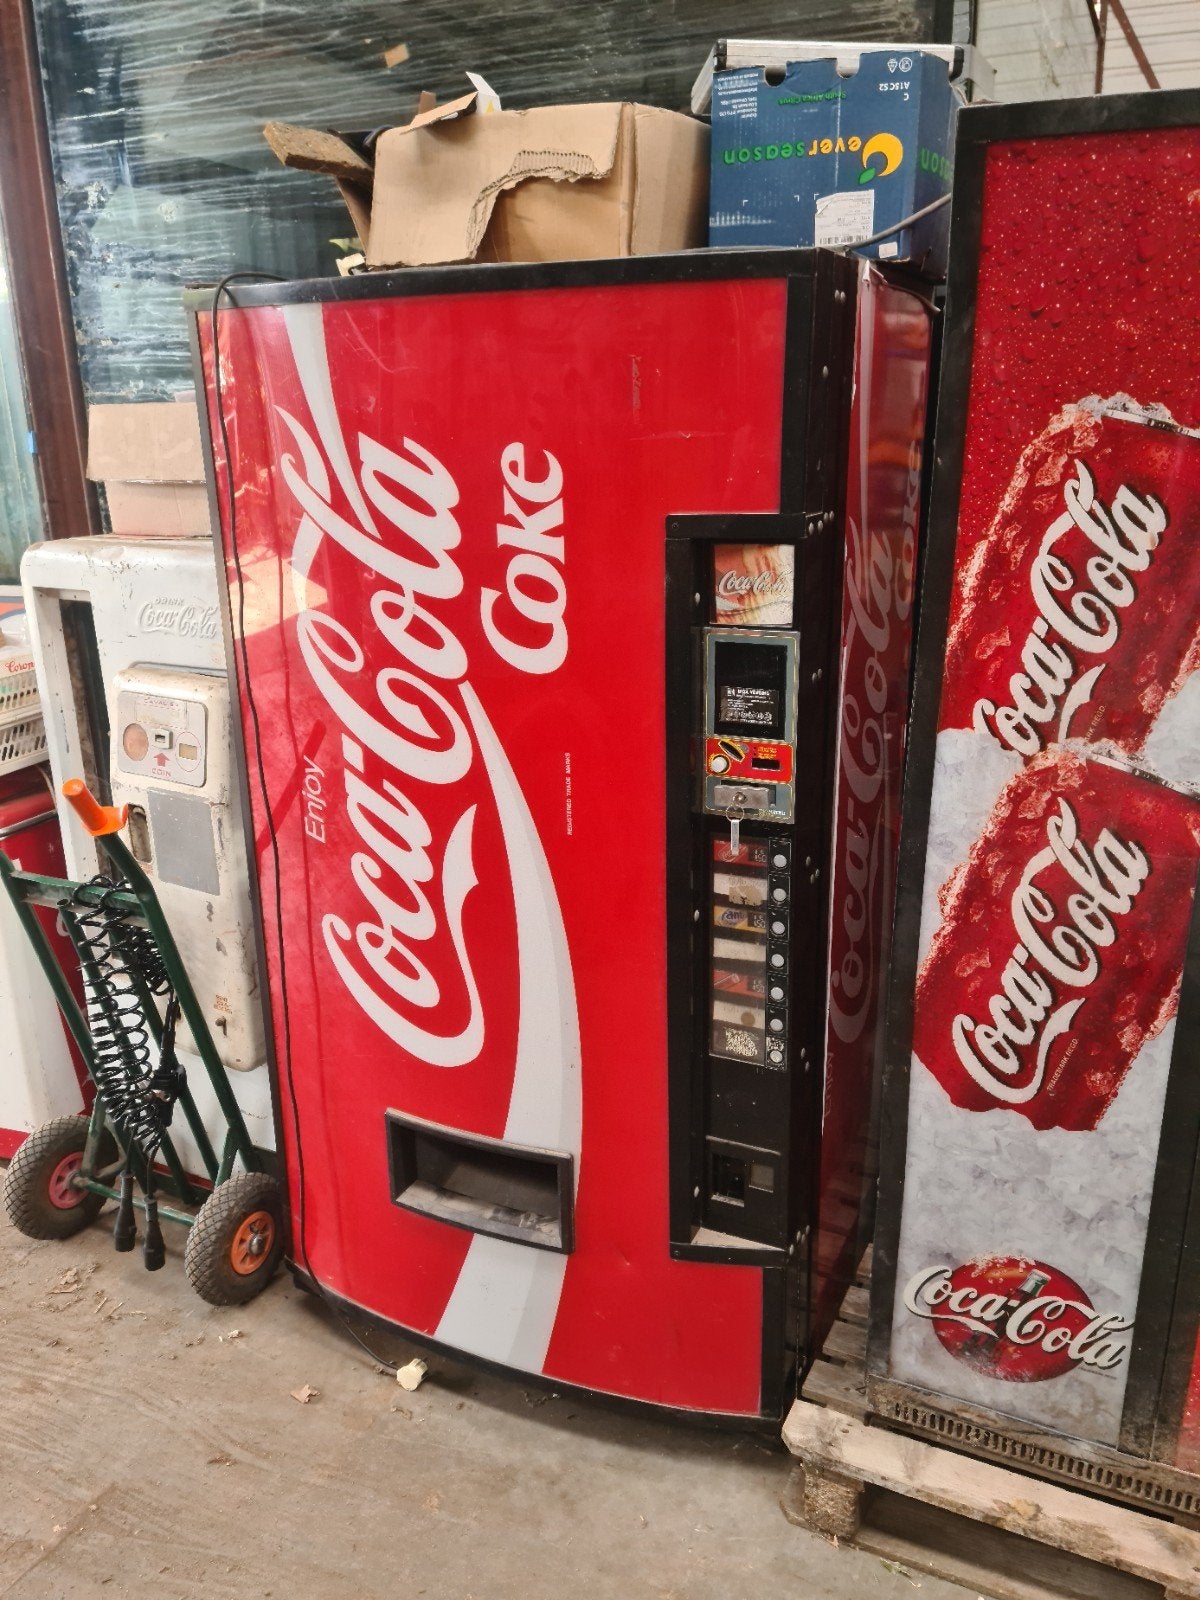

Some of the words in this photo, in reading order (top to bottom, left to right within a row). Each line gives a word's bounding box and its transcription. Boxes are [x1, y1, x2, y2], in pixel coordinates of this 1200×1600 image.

[801, 94, 824, 103] Africa
[723, 140, 806, 166] season
[807, 135, 862, 157] ever
[480, 442, 569, 675] Coke
[139, 602, 219, 638] Coca-Cola
[154, 597, 185, 606] DRINK
[274, 405, 485, 1067] Coca-Cola
[151, 768, 172, 777] COIN
[304, 755, 329, 844] Enjoy
[830, 516, 894, 1044] Coca-Cola
[952, 796, 1150, 1104] Coca-Cola
[903, 1264, 1136, 1370] Coca-Cola
